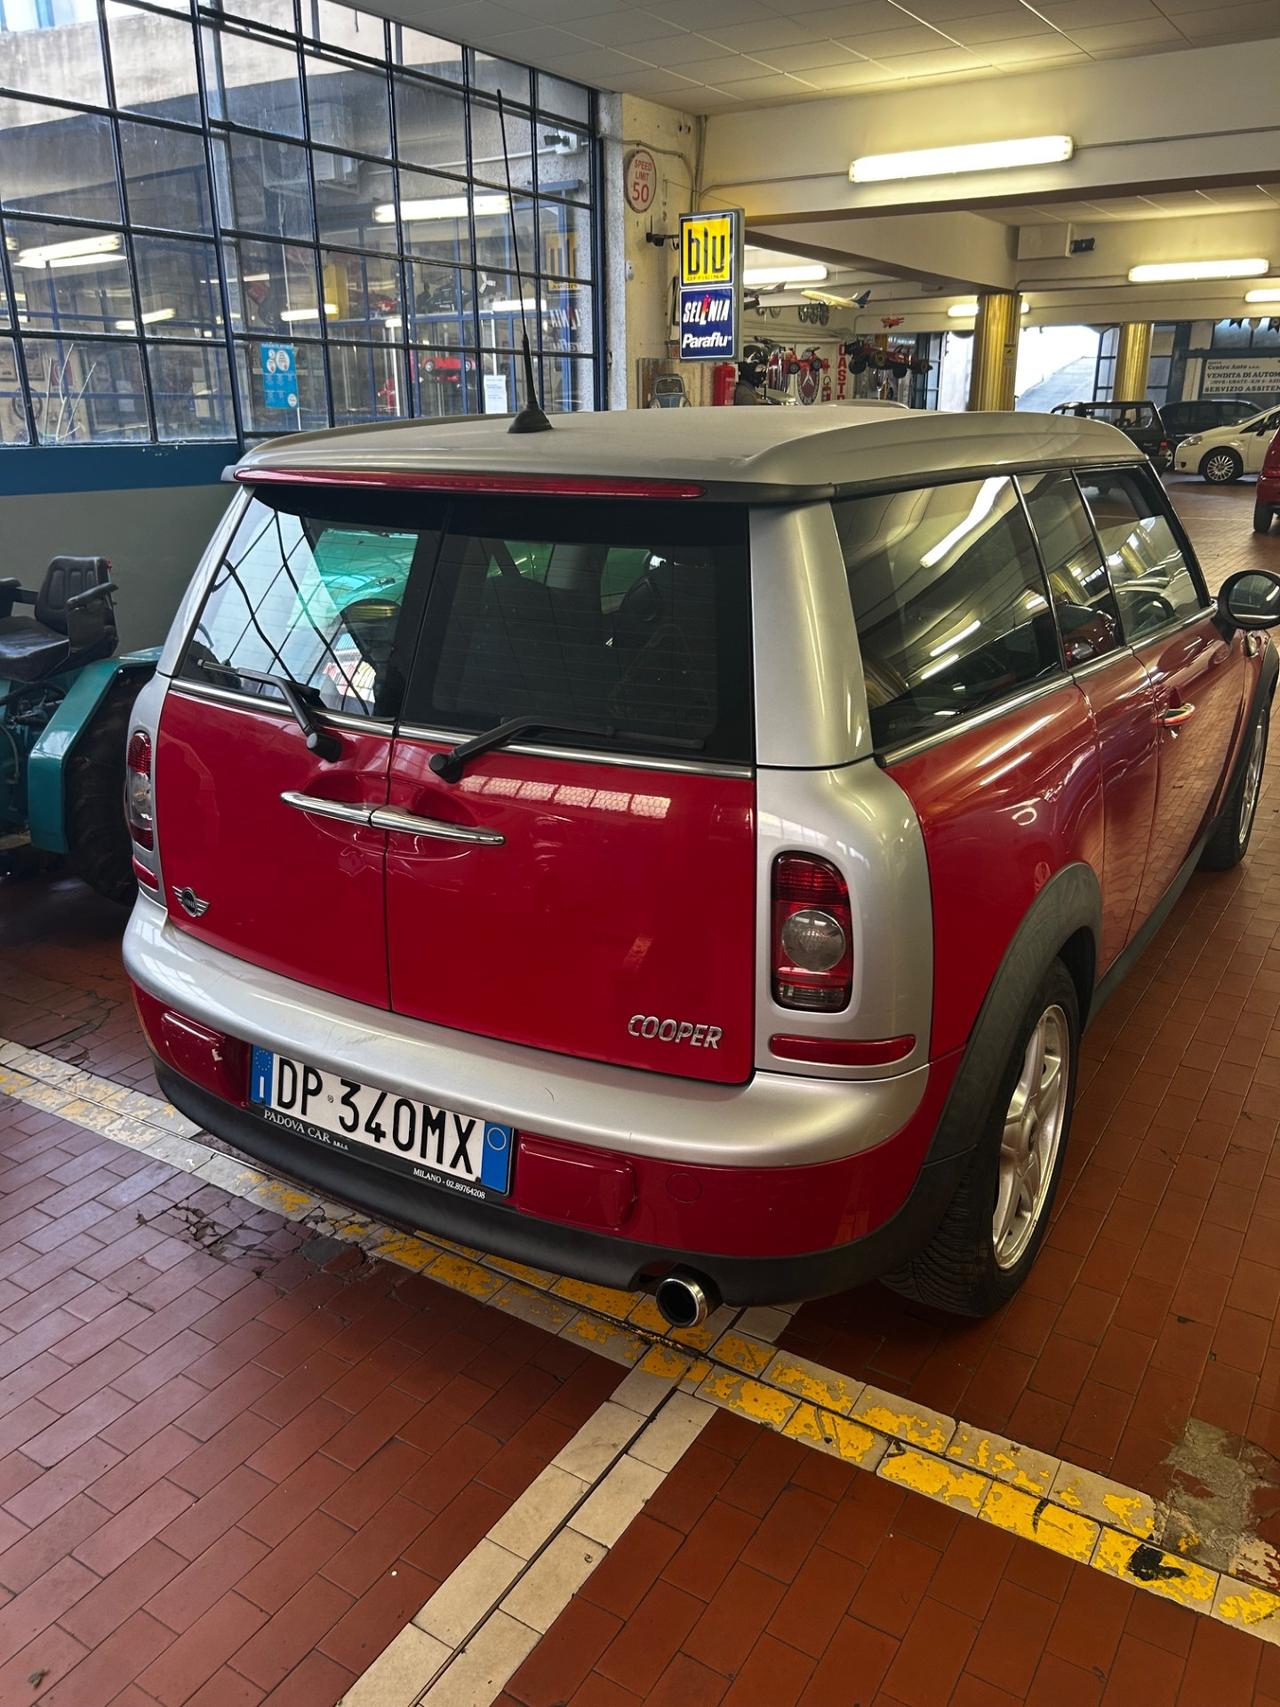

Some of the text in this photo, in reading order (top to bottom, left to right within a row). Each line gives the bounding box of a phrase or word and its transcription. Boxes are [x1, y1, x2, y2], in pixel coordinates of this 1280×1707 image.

[634, 159, 652, 171] SPEED
[635, 170, 649, 180] LIMIT
[632, 182, 649, 202] 50
[682, 294, 730, 325] SELENIA
[682, 332, 728, 348] Paraflu
[627, 1014, 723, 1049] COOPER
[277, 1056, 477, 1175] DP 340MX
[264, 1109, 305, 1134] PADOVA
[307, 1127, 331, 1144] CAR
[413, 1167, 442, 1184] MILANO
